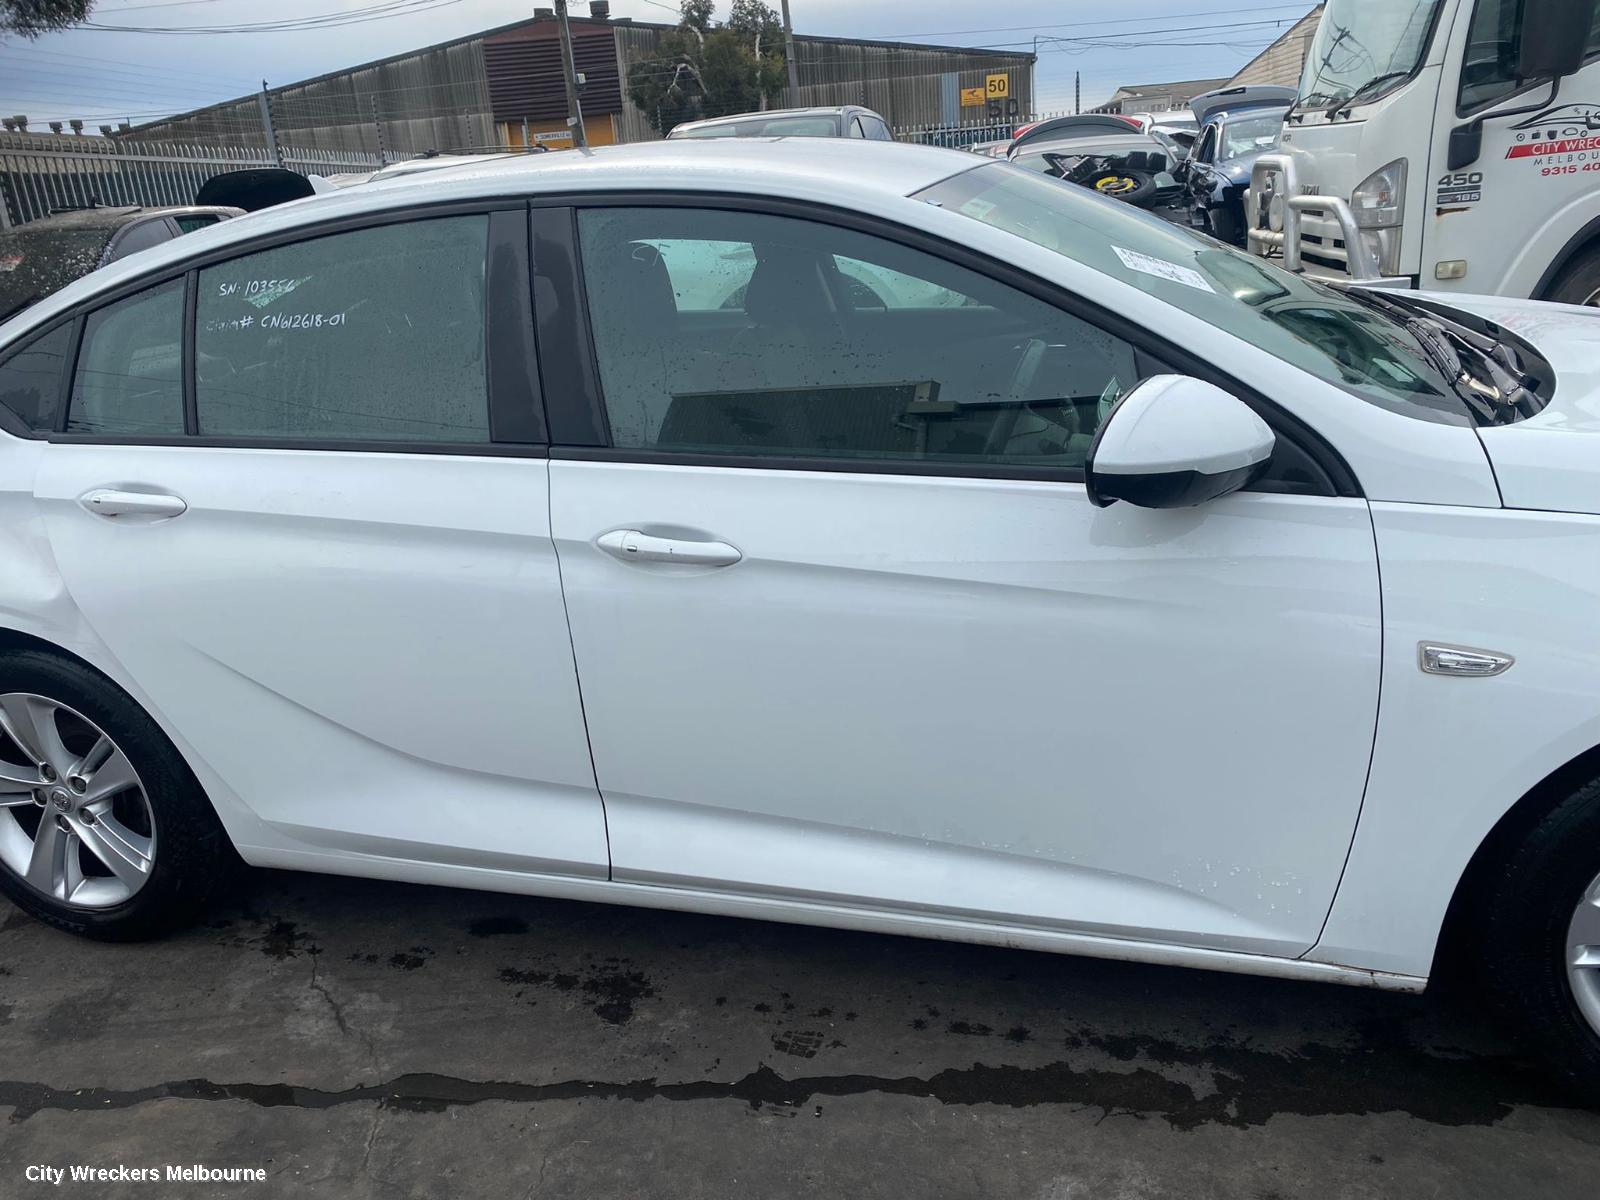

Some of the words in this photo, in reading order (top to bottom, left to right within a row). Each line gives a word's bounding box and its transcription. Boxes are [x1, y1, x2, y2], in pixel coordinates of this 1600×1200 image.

[988, 79, 1006, 93] 50
[1532, 141, 1561, 155] CITY
[1533, 151, 1599, 167] MELBOU
[1541, 165, 1577, 176] 9315
[1582, 162, 1600, 172] 40
[1438, 172, 1483, 186] 450
[219, 282, 241, 296] SN:
[261, 312, 346, 329] CN612618-01
